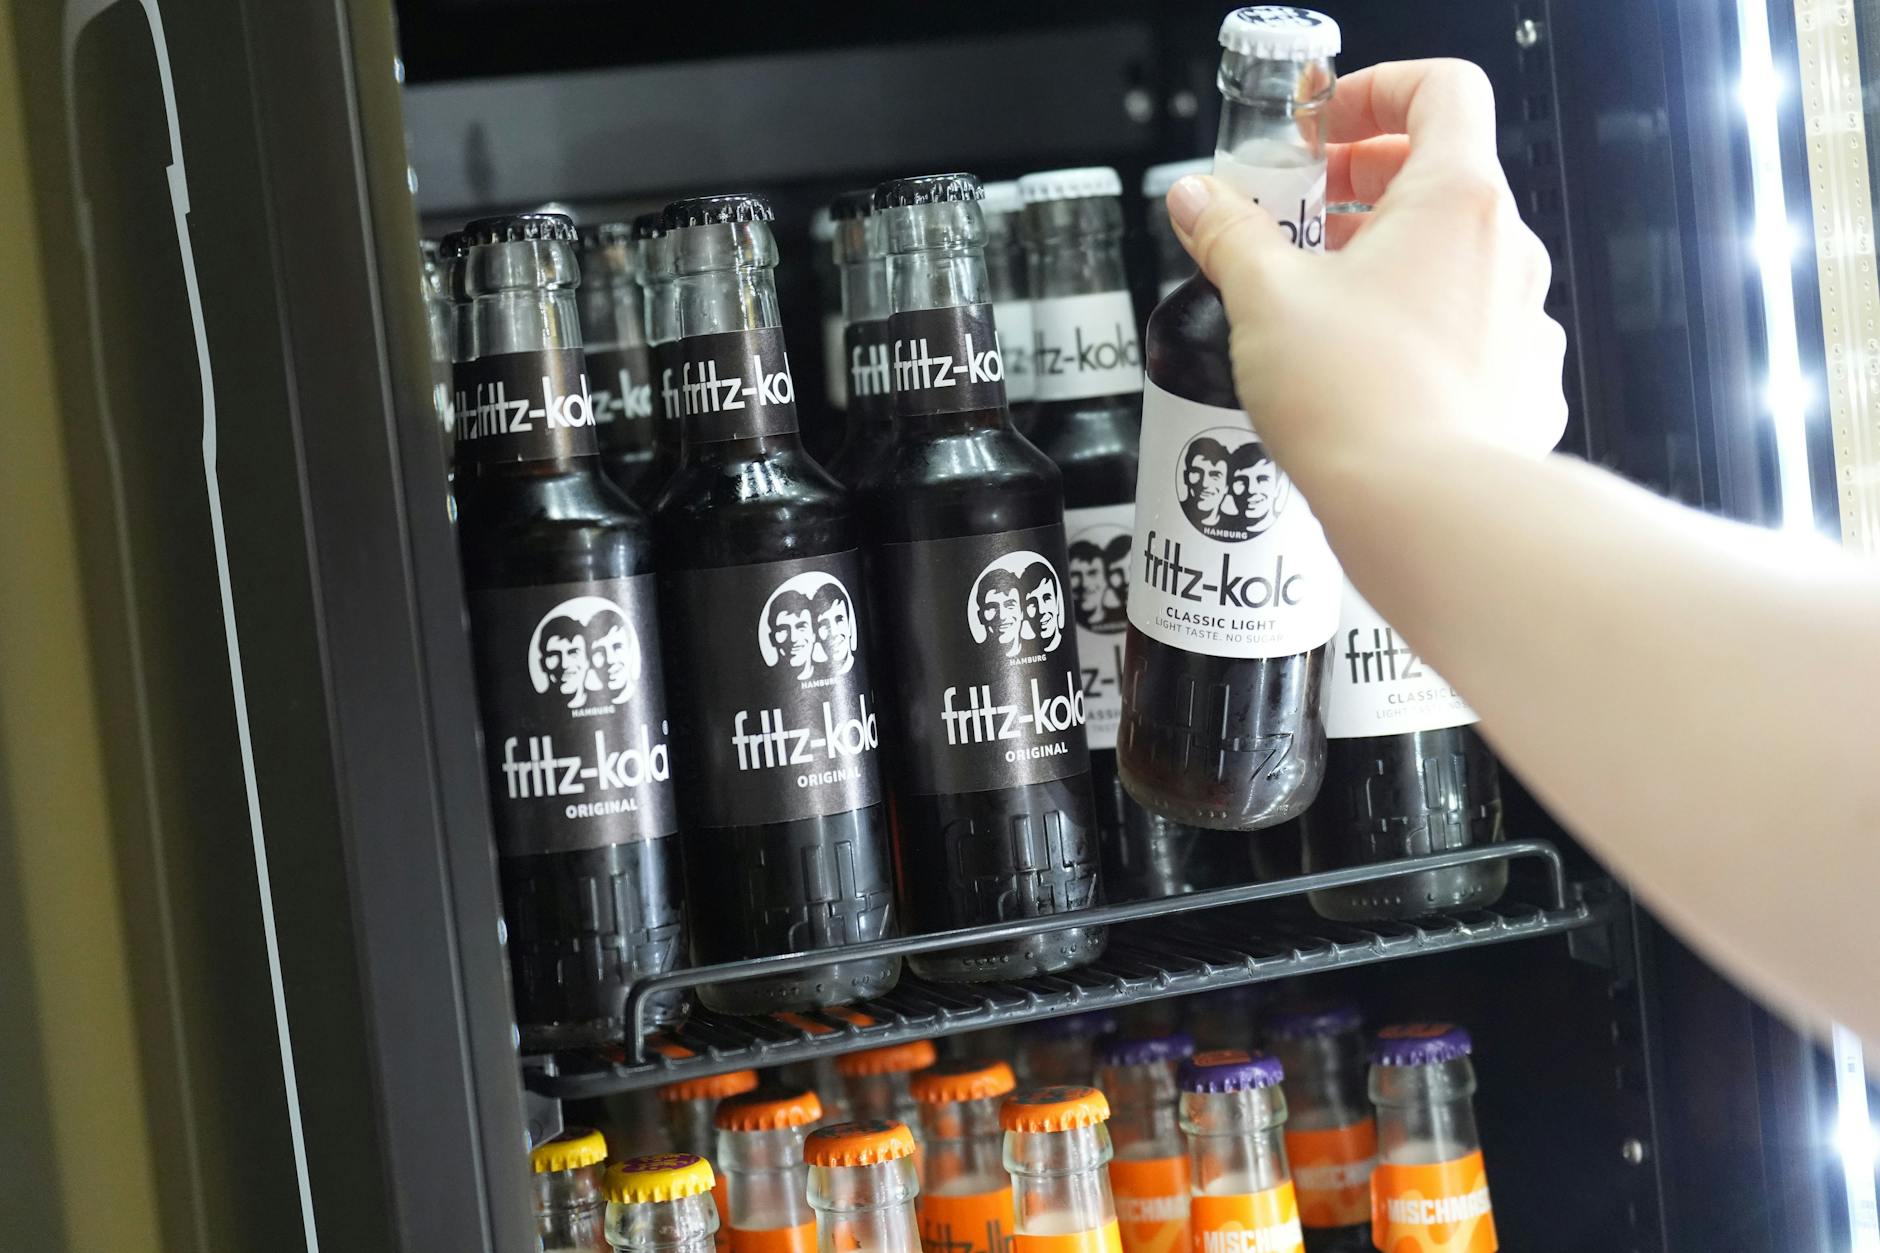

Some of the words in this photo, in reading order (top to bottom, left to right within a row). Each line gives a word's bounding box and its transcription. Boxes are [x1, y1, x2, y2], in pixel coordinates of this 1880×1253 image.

[1203, 526, 1248, 540] HAMBURG
[1166, 606, 1226, 629] CLASSIC
[1231, 620, 1277, 631] LIGHT
[1155, 617, 1182, 634] LIGHT
[1226, 633, 1243, 643] NO
[1009, 653, 1047, 666] HAMBURG
[571, 704, 616, 718] HAMBURG
[731, 693, 879, 771] fritz-kola
[1005, 741, 1069, 763] ORIGINAL
[797, 766, 861, 788] ORIGINAL
[565, 798, 638, 819] ORIGINAL
